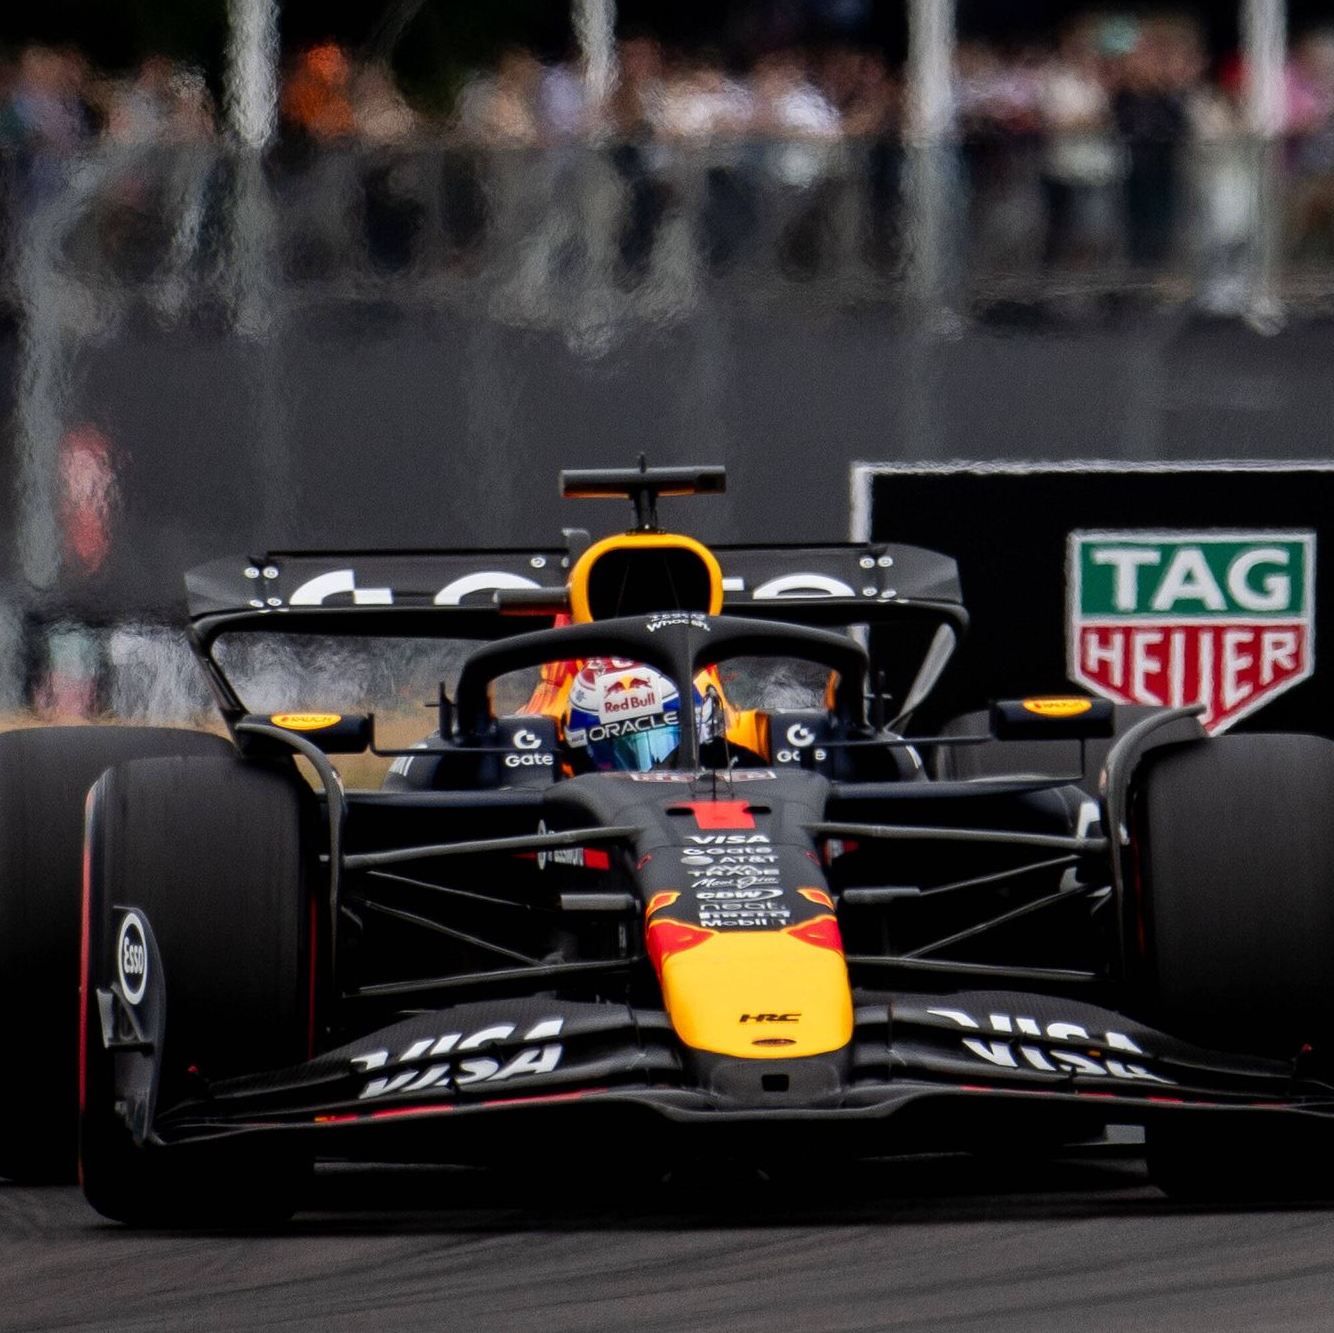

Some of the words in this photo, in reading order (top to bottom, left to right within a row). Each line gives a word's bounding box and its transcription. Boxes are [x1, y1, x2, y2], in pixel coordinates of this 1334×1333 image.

[1092, 548, 1292, 611] TAG
[1084, 629, 1299, 723] HEUER
[604, 698, 629, 714] Red
[630, 692, 656, 708] Bull
[589, 711, 679, 742] ORACLE
[505, 753, 554, 767] Gate
[685, 835, 770, 844] VISA
[719, 855, 779, 864] AT&T
[696, 891, 763, 899] CDW
[700, 918, 768, 927] Mobil
[740, 1013, 802, 1024] HRC
